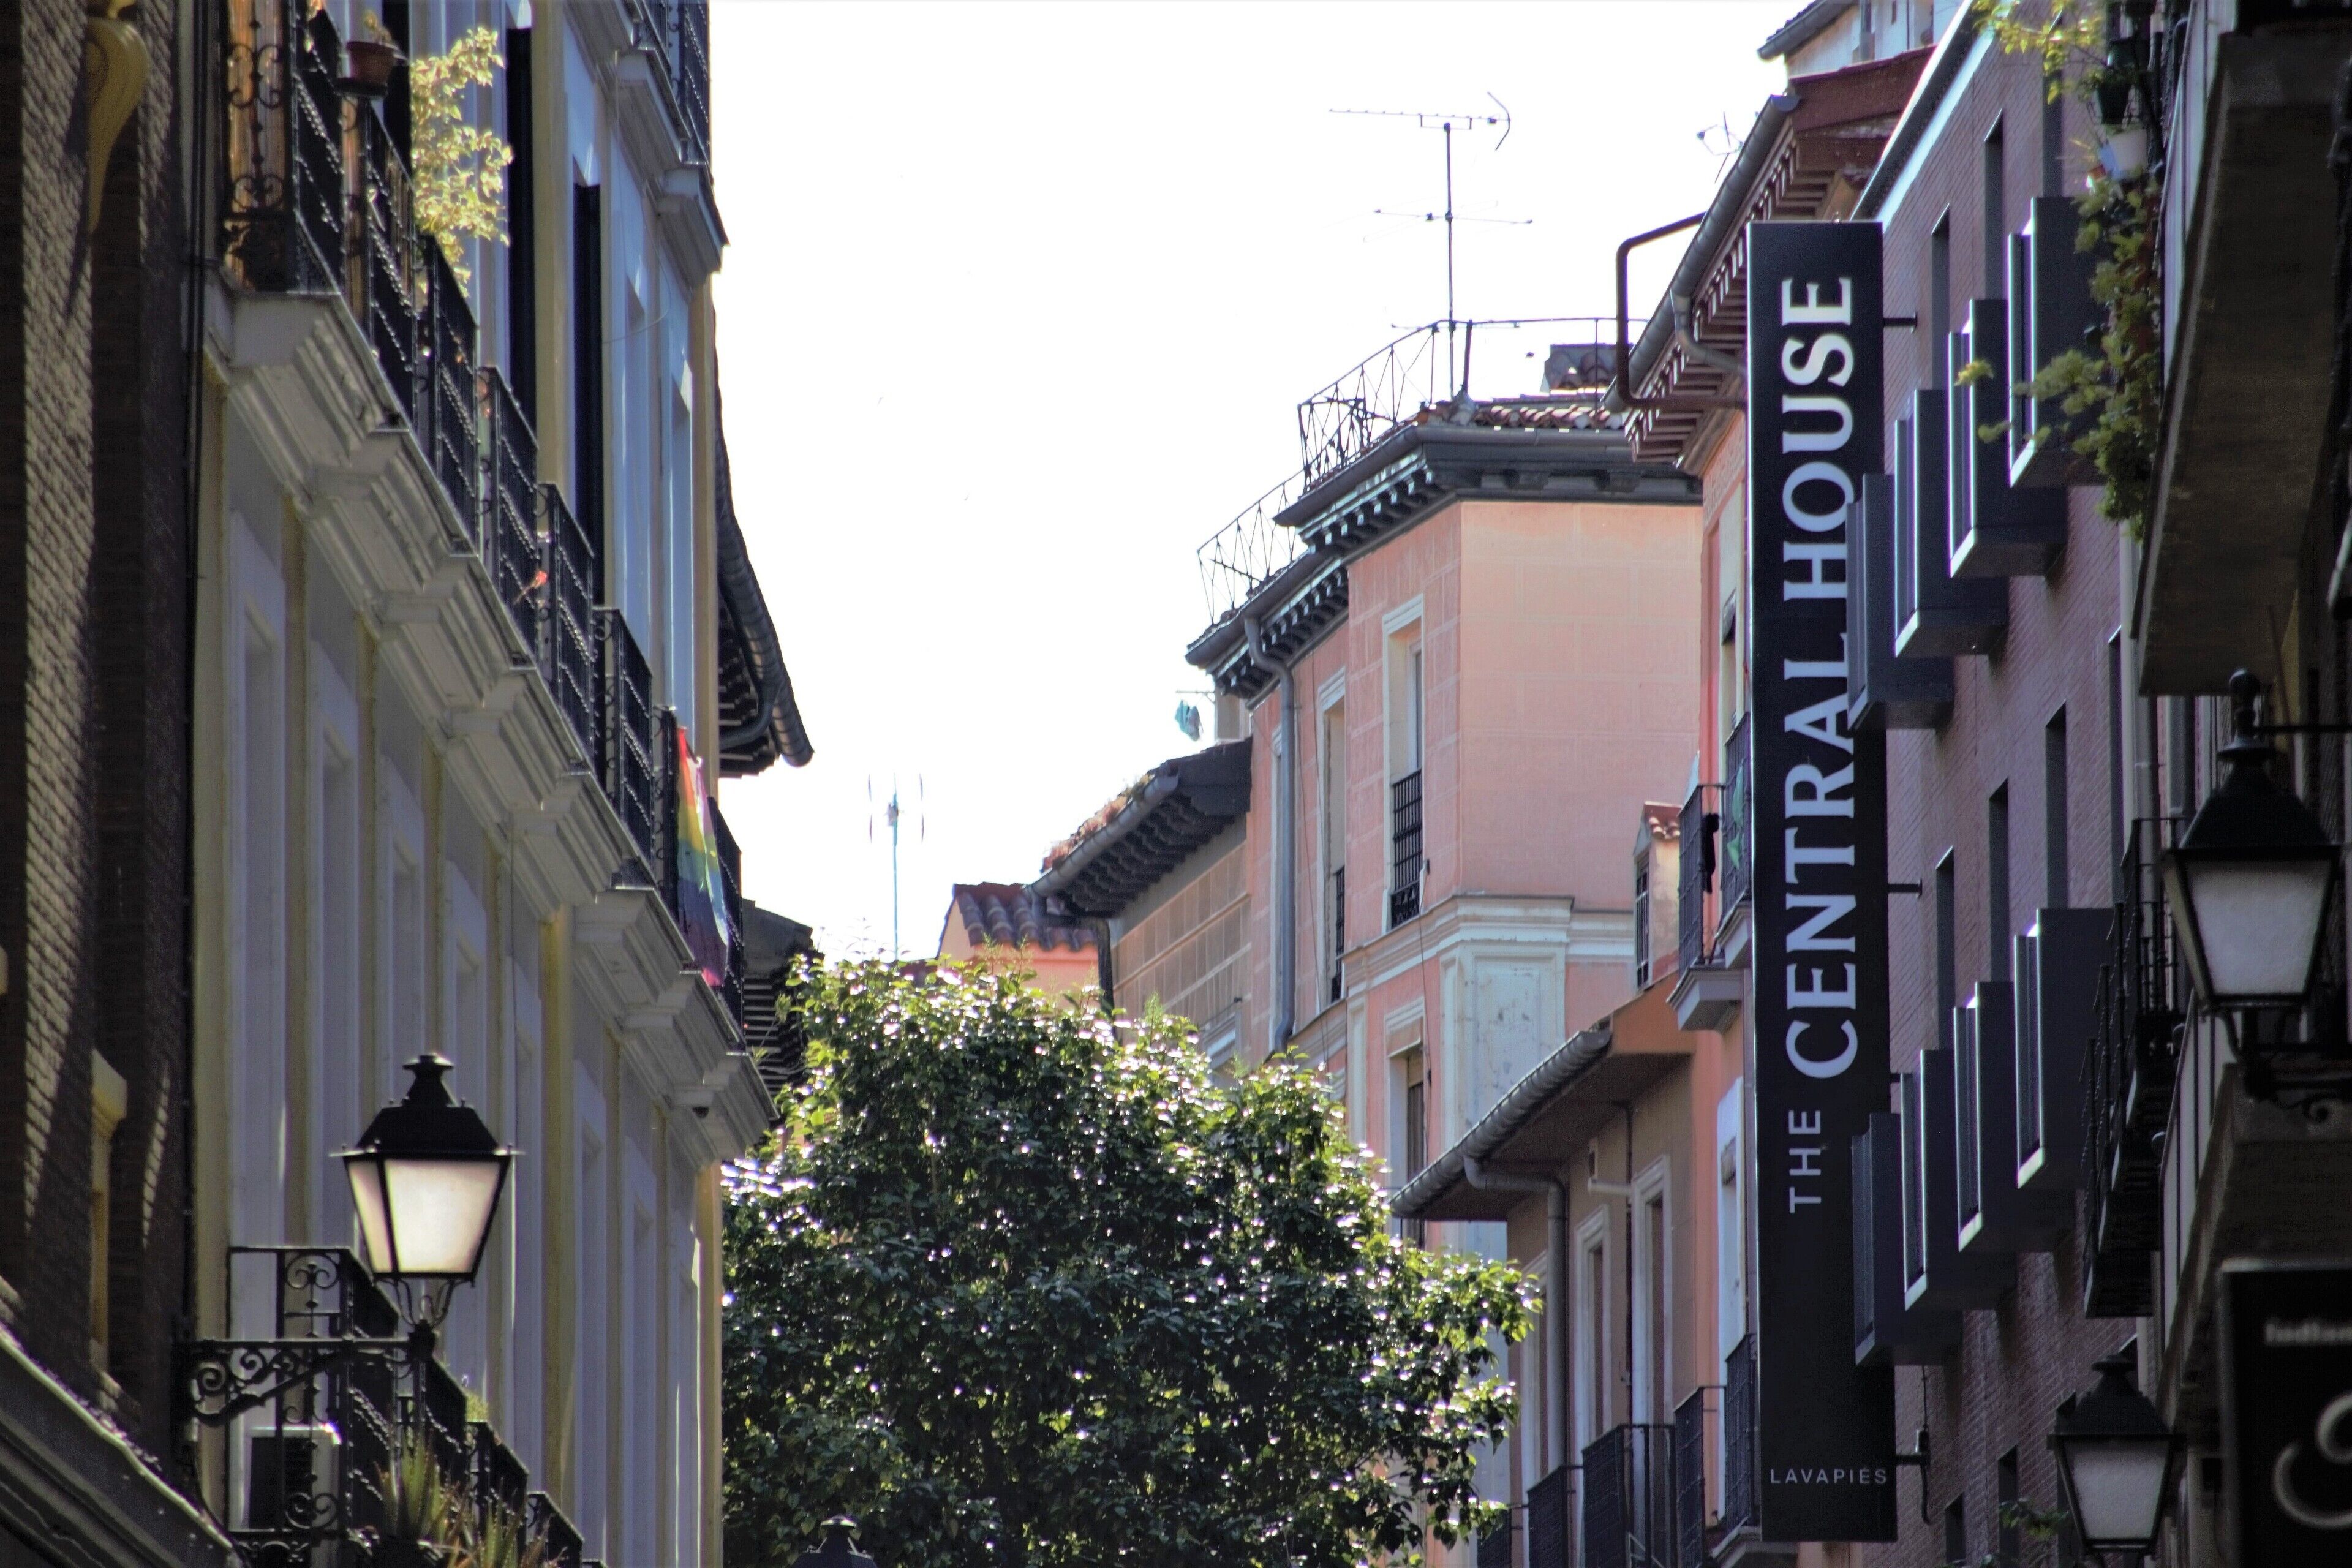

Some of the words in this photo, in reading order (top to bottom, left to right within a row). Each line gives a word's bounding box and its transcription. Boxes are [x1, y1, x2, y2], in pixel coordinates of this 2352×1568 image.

[1781, 277, 1854, 602] HOUSE
[1784, 631, 1858, 1079] CENTRAL
[1788, 1110, 1822, 1214] THE
[1770, 1467, 1887, 1485] LAVAPIÉS
